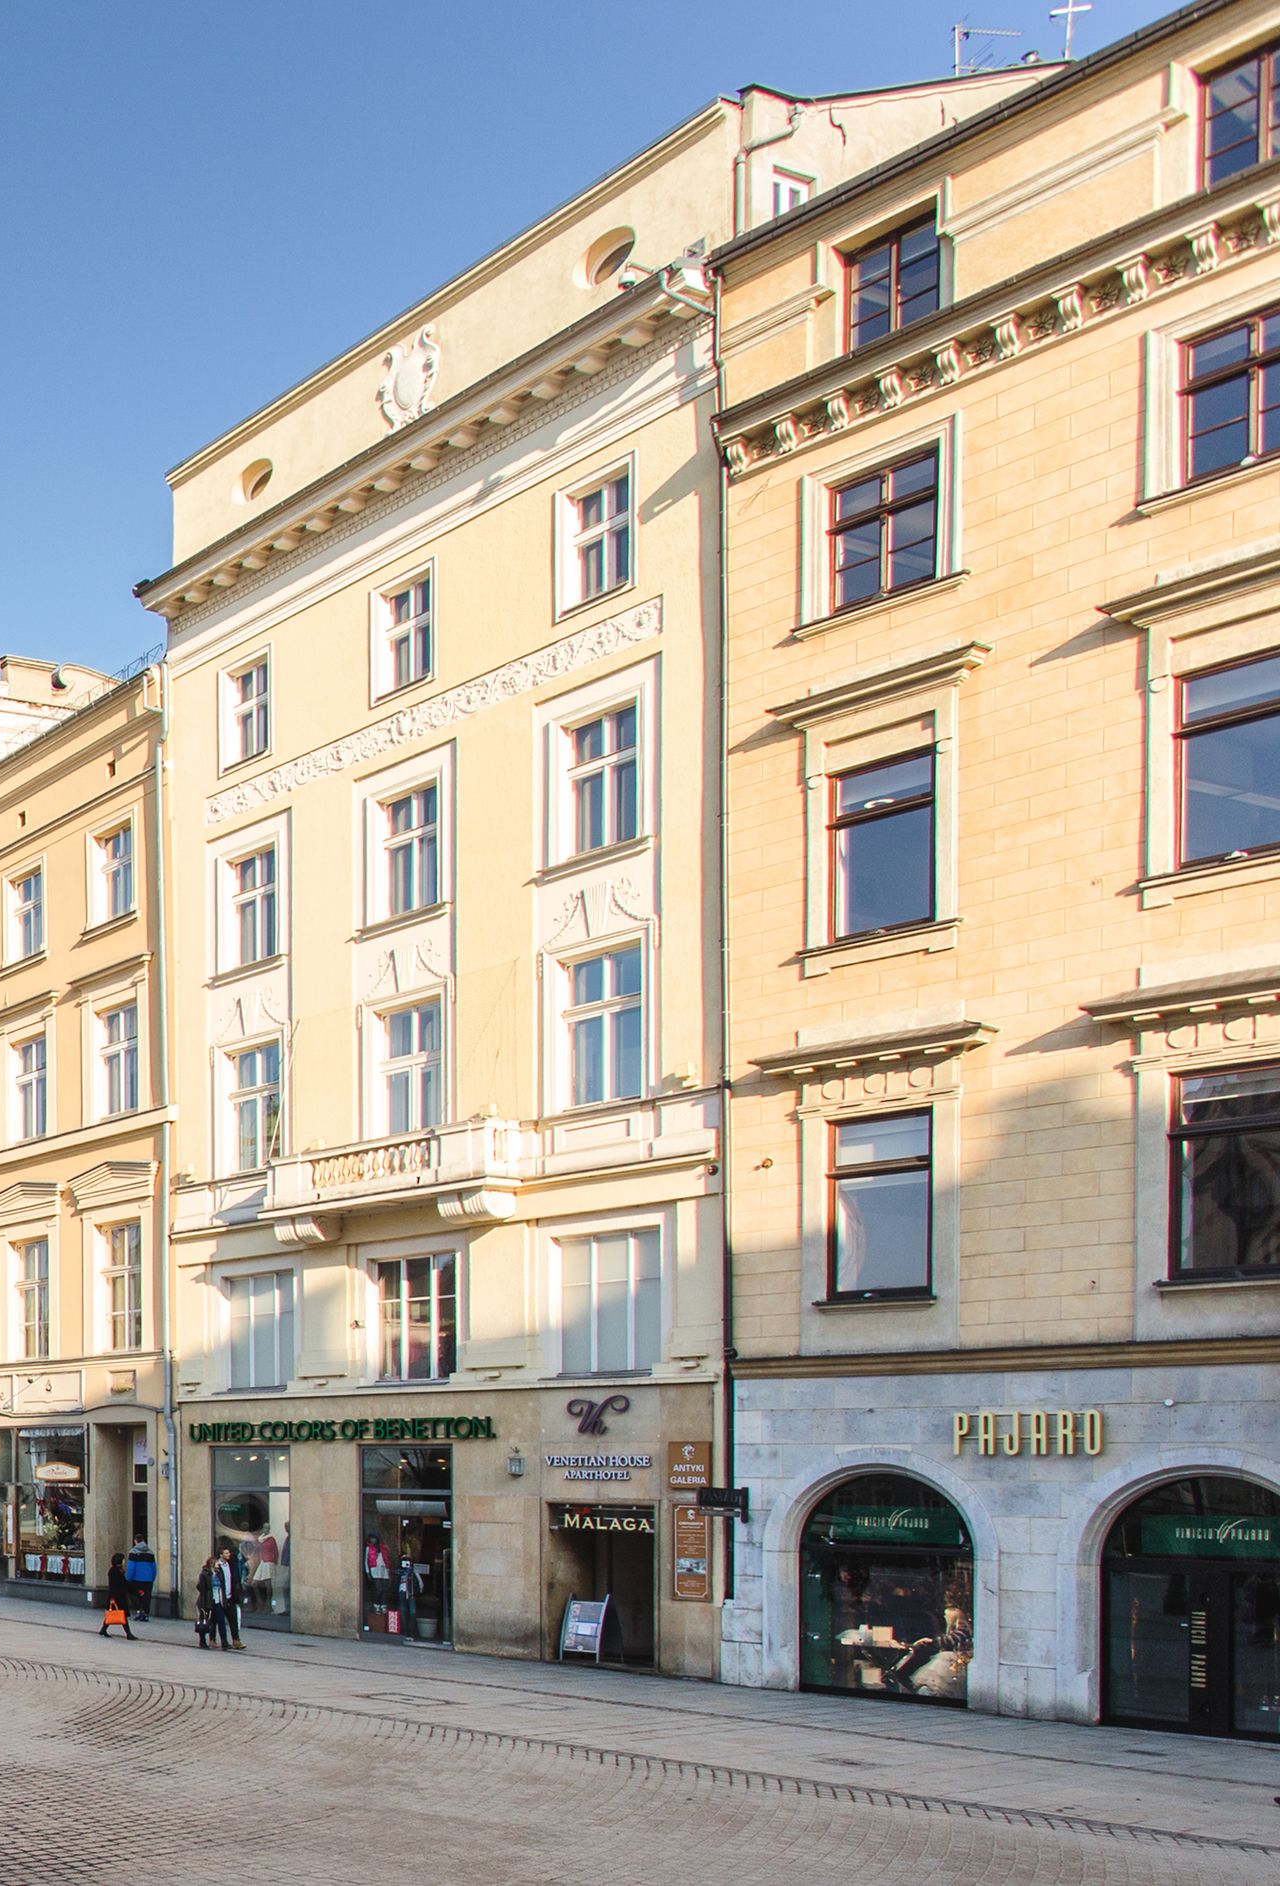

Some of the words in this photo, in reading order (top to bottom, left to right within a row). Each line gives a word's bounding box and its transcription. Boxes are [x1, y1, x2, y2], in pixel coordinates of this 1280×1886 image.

[190, 1421, 255, 1442] UNITED
[259, 1420, 337, 1441] COLORS
[340, 1419, 370, 1441] OF
[953, 1409, 1104, 1457] PAJARO
[544, 1455, 608, 1467] VENETIAN
[609, 1455, 651, 1468] HOUSE
[673, 1464, 704, 1472] ANTYKI
[563, 1470, 631, 1480] APARTHOTEL
[670, 1476, 706, 1484] GALERIA
[564, 1513, 651, 1531] MALAGA
[899, 1518, 929, 1529] PAJARO
[1230, 1528, 1269, 1541] PAJARO
[1190, 1654, 1207, 1688] PAJARO
